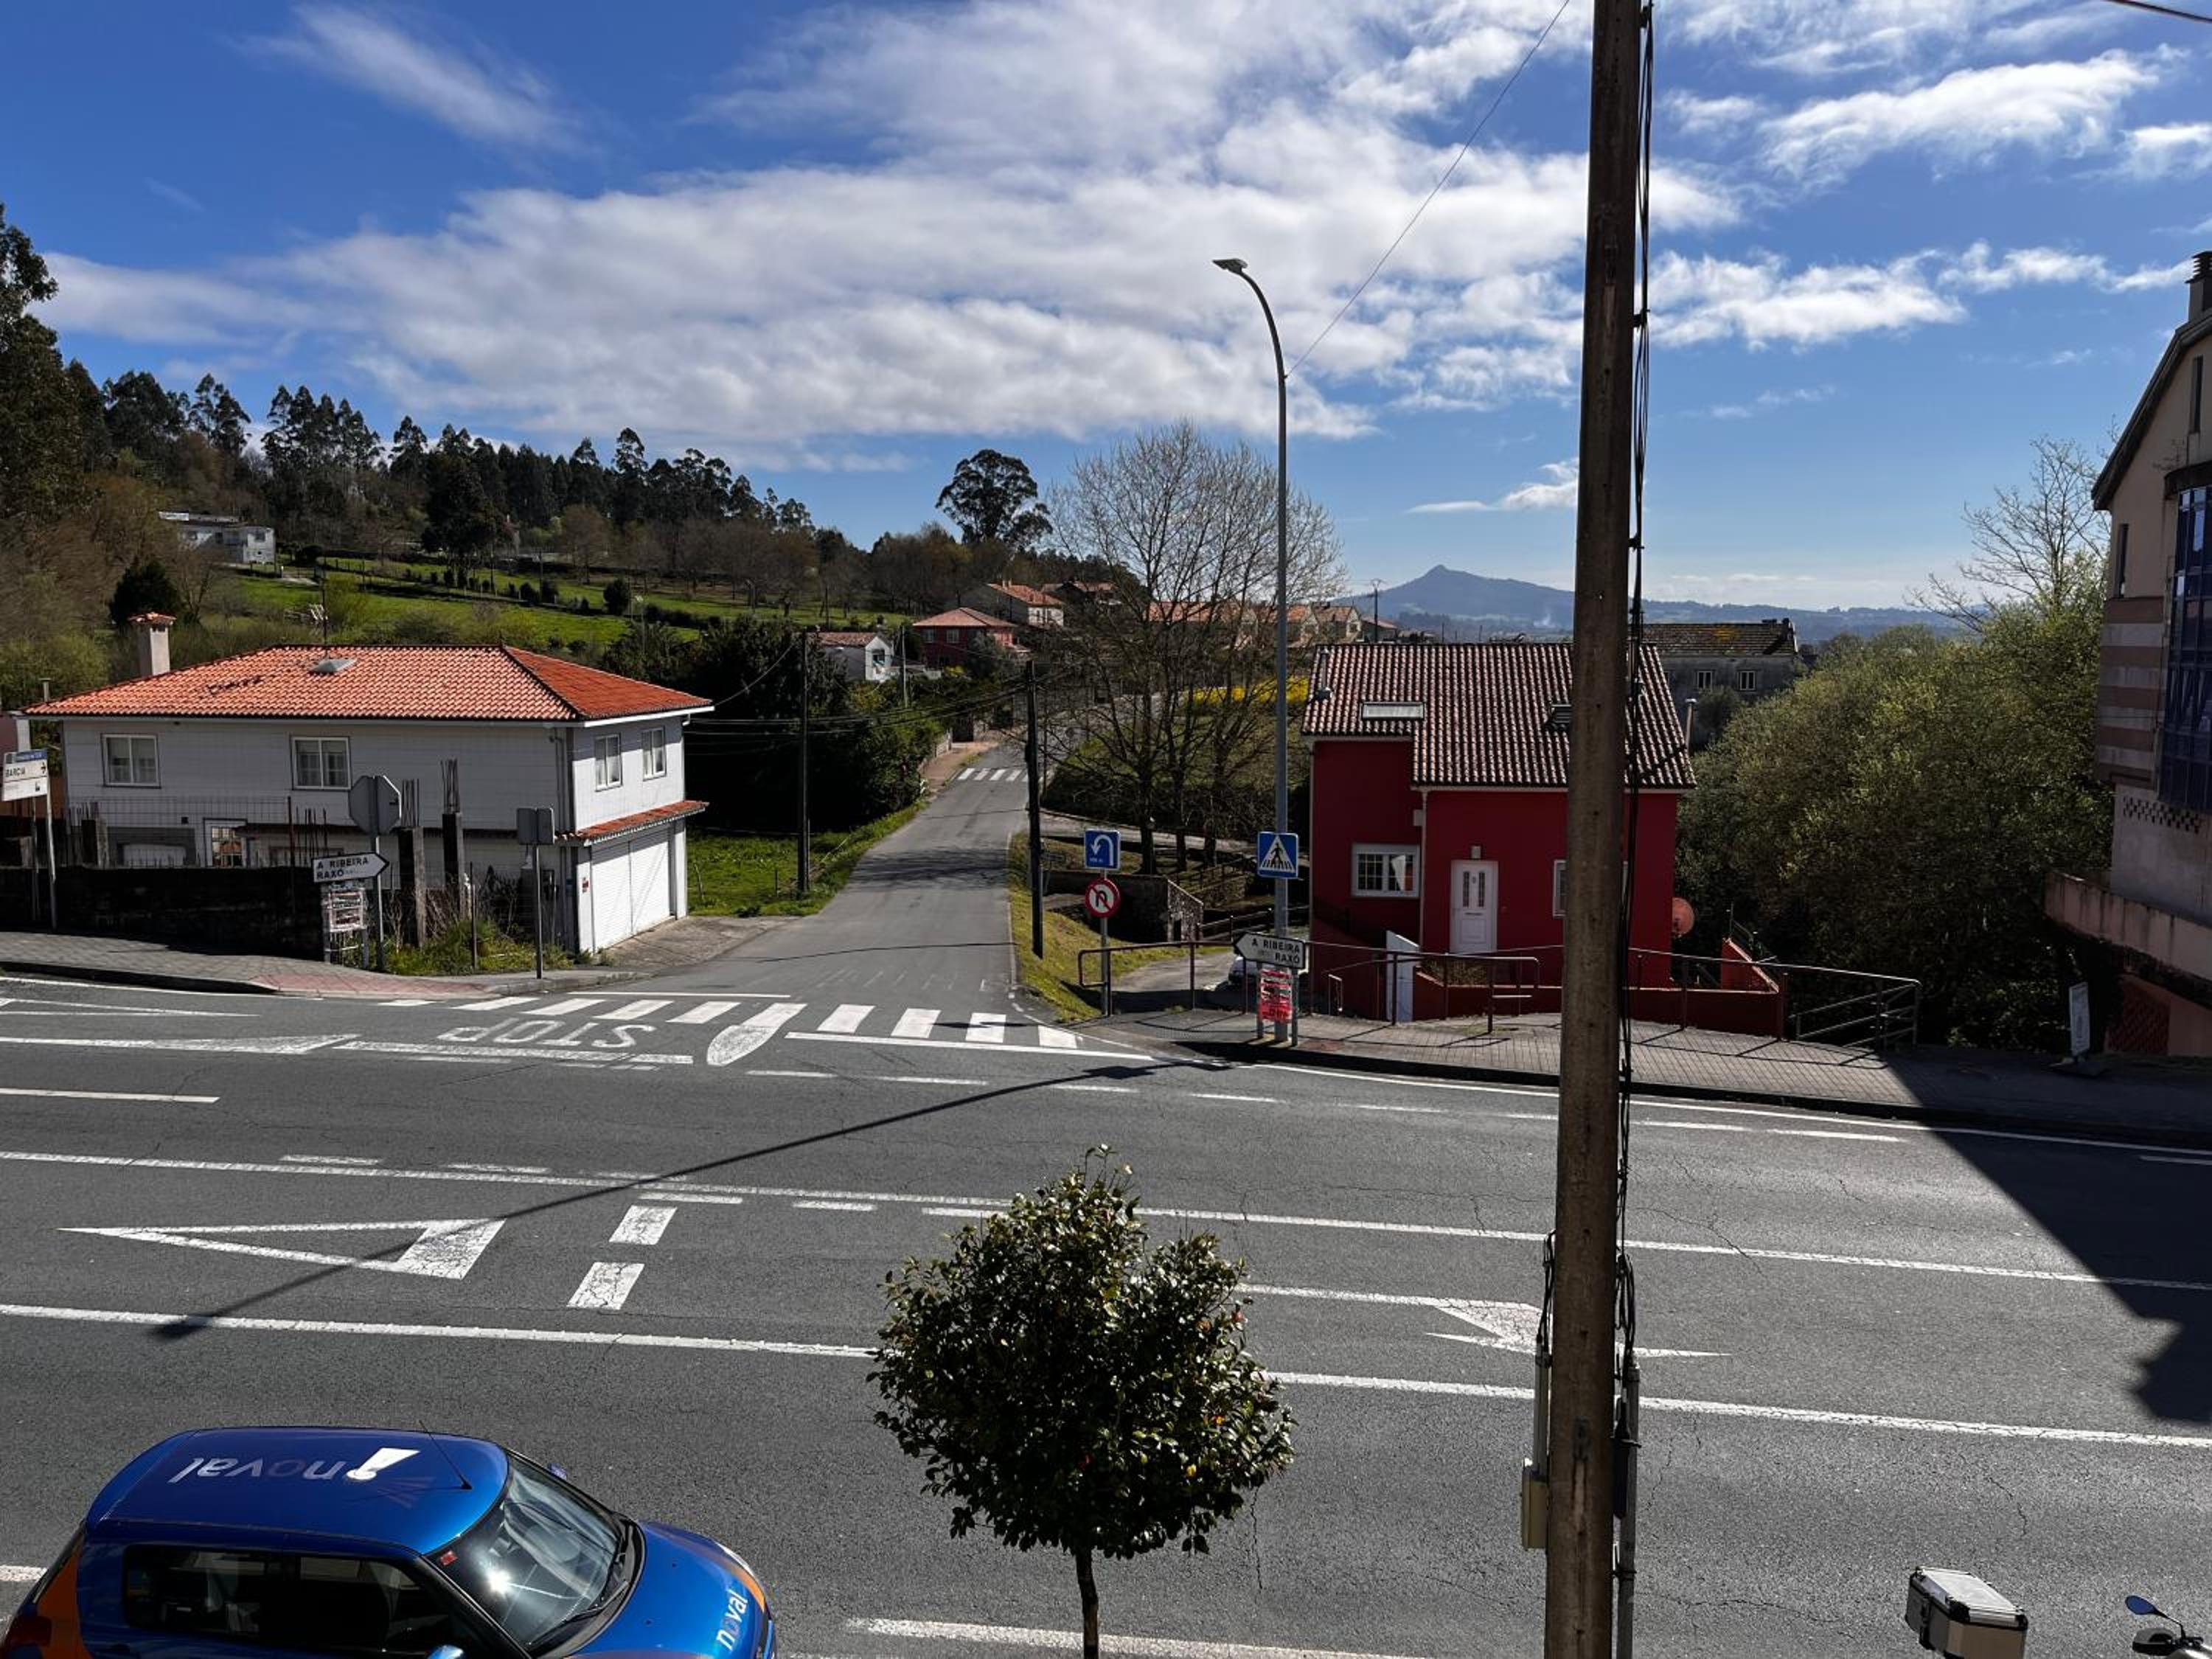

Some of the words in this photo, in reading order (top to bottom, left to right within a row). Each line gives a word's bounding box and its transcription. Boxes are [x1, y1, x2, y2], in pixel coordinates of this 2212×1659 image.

[317, 860, 324, 869] A
[330, 857, 369, 868] RIBEIRA
[1251, 938, 1258, 947] A
[1263, 939, 1300, 953] RIBEIRA
[437, 1017, 656, 1048] STOP
[167, 1456, 348, 1484] noval
[715, 1587, 748, 1651] noval
